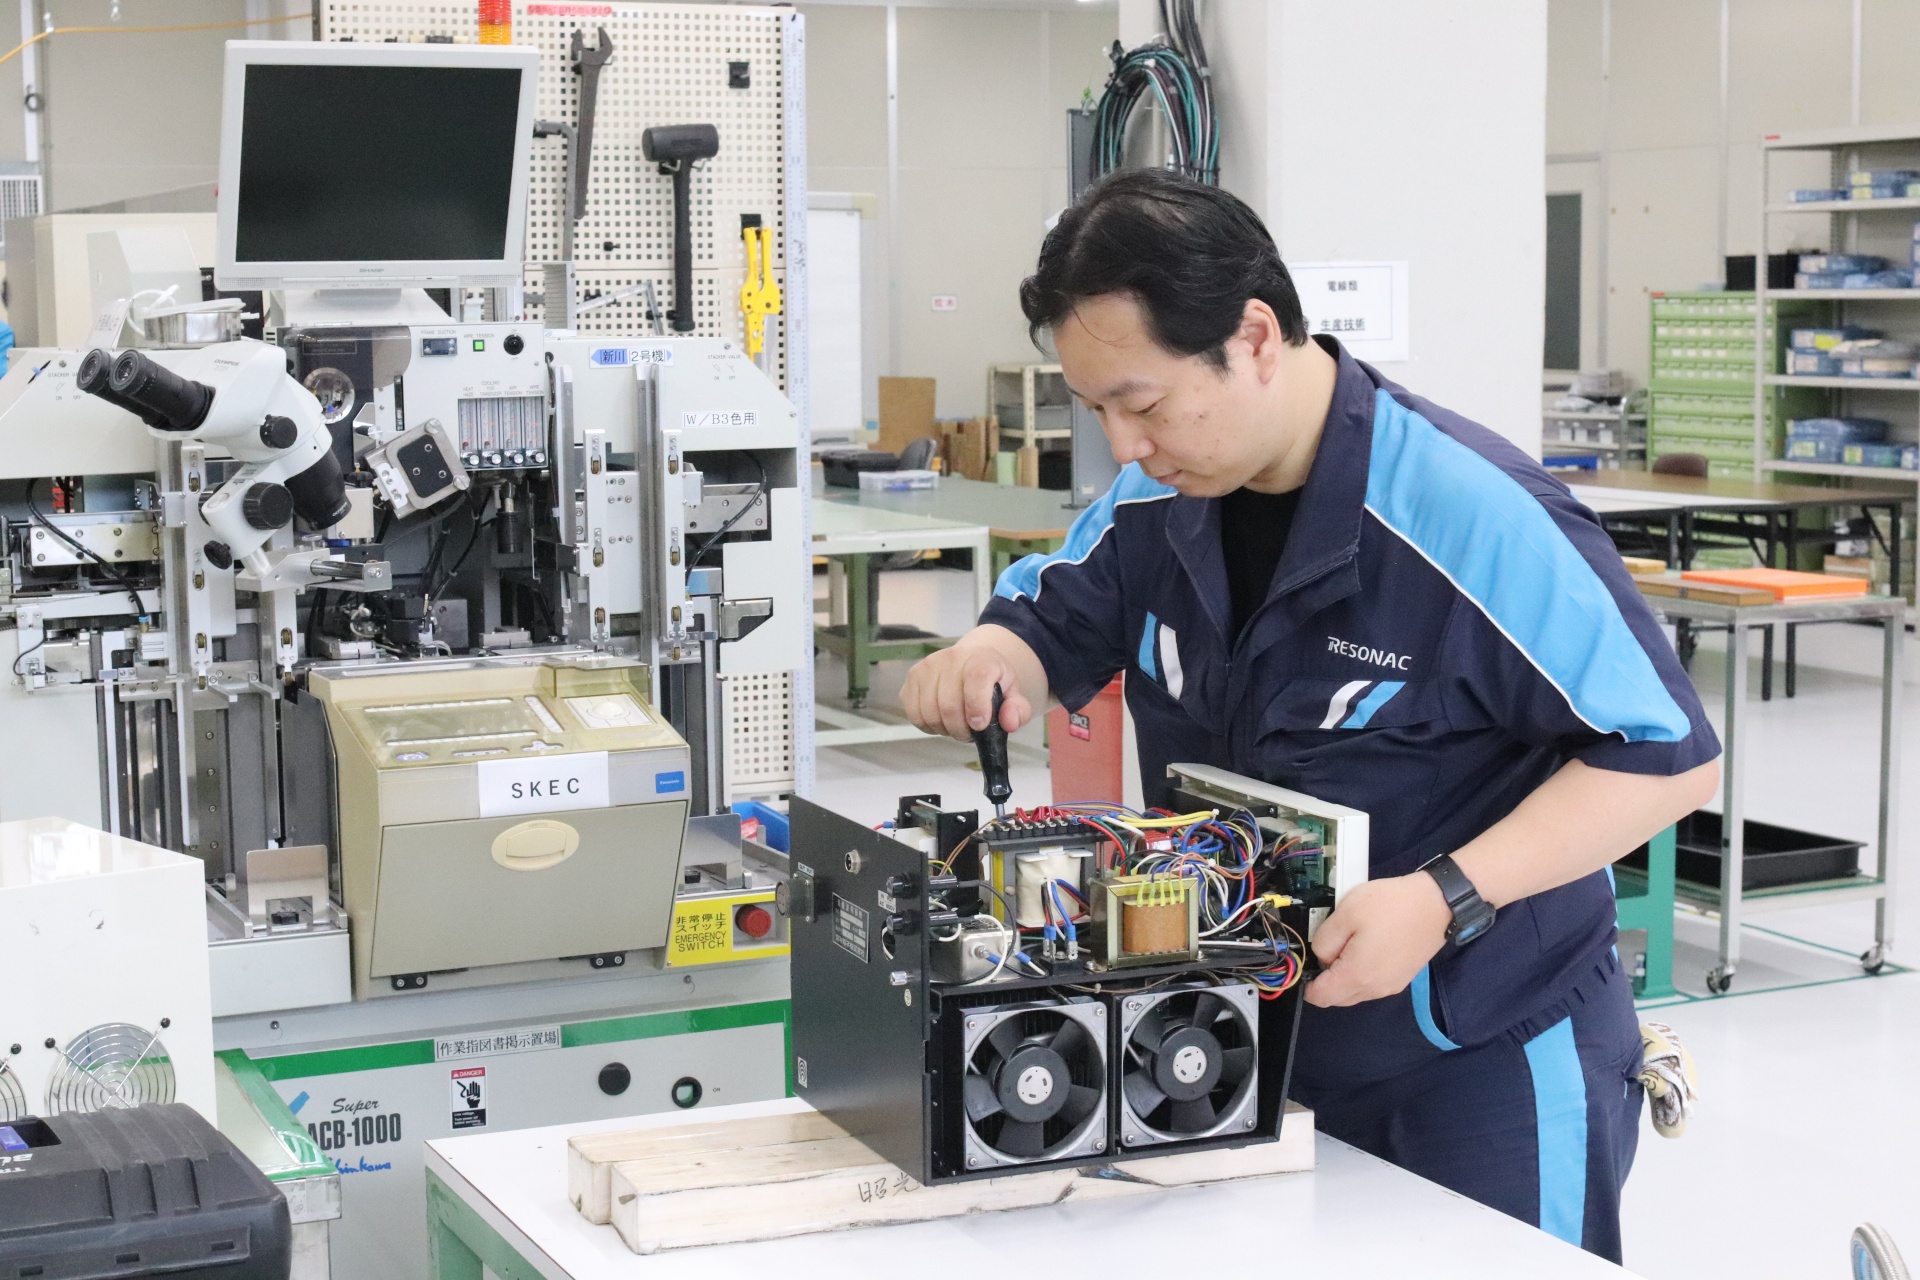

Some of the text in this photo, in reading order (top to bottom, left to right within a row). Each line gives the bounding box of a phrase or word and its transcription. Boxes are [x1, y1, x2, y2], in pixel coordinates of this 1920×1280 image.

[1327, 280, 1358, 292] 電線類
[1320, 318, 1366, 331] 生産技術
[602, 349, 665, 363] 新川 2号機
[1327, 636, 1413, 671] RESONAC
[511, 777, 580, 799] SKEC
[675, 912, 726, 925] 非常停止
[675, 920, 727, 934] スイッチ
[675, 931, 727, 944] EMERGENCY
[678, 940, 725, 953] SWITCH
[440, 1030, 557, 1056] 作業指図書掲示置場
[331, 1098, 380, 1115] Super
[308, 1112, 402, 1151] ACB-1000
